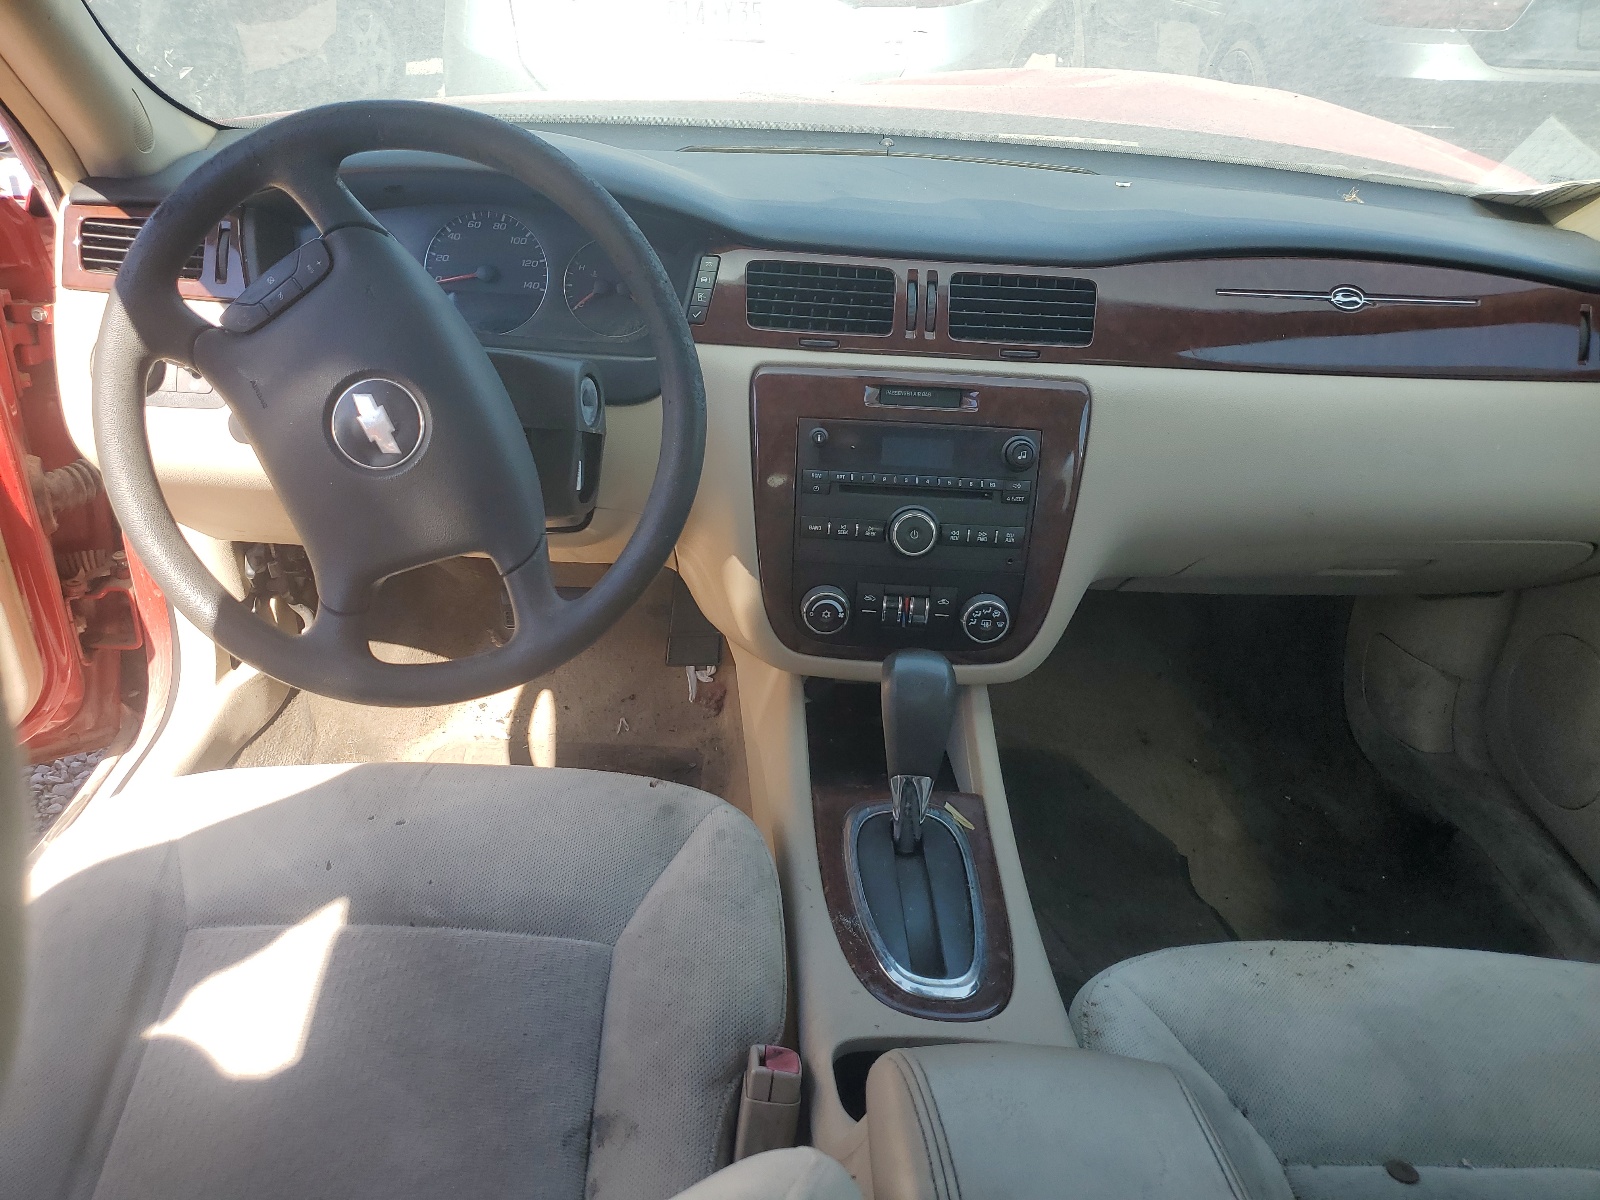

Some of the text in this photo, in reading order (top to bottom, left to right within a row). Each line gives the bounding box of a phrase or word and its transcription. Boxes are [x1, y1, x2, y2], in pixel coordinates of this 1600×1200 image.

[467, 221, 482, 229] 60
[493, 222, 507, 231] 80
[447, 232, 461, 241] 40
[510, 237, 528, 245] 100
[436, 254, 450, 262] 20
[521, 260, 539, 268] 120
[523, 282, 540, 290] 140
